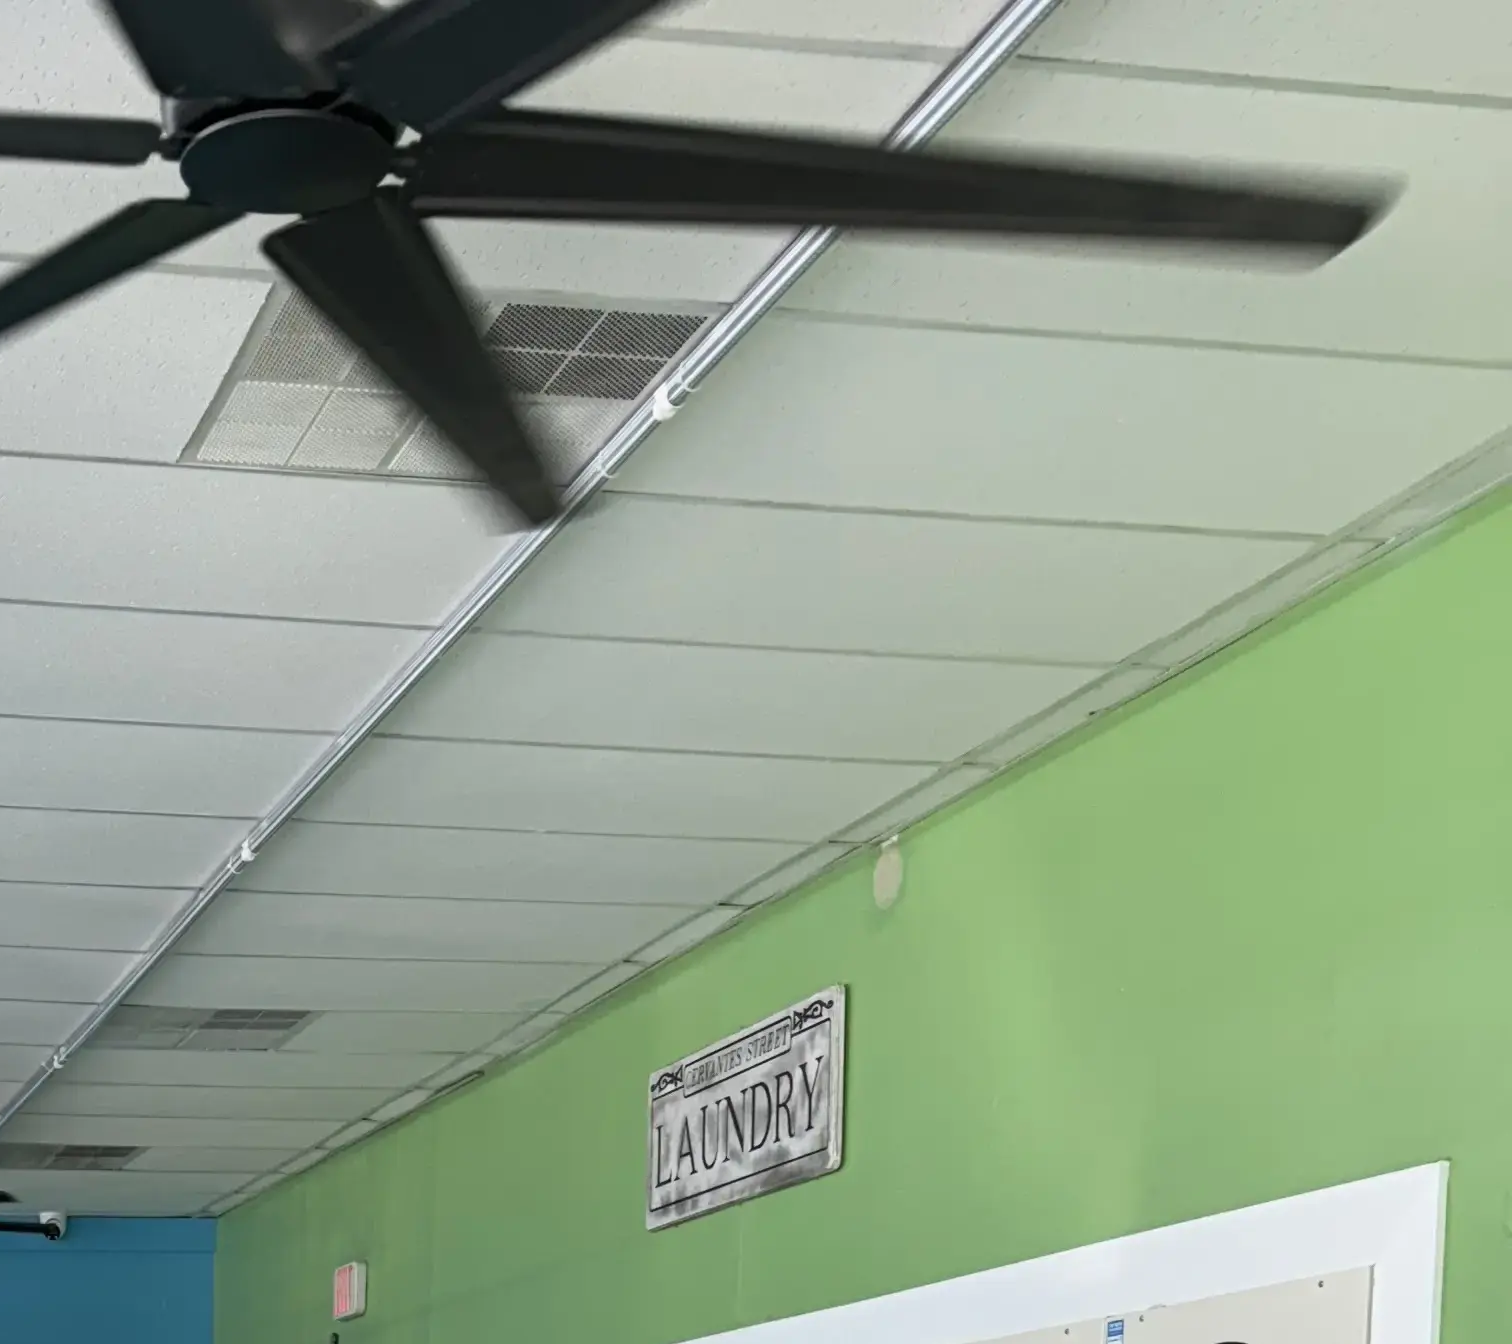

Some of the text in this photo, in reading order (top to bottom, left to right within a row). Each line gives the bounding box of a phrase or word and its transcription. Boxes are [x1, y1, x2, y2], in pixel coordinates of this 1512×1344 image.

[685, 1023, 790, 1089] CERVANTES STREET
[654, 1055, 825, 1189] LAUNDRY
